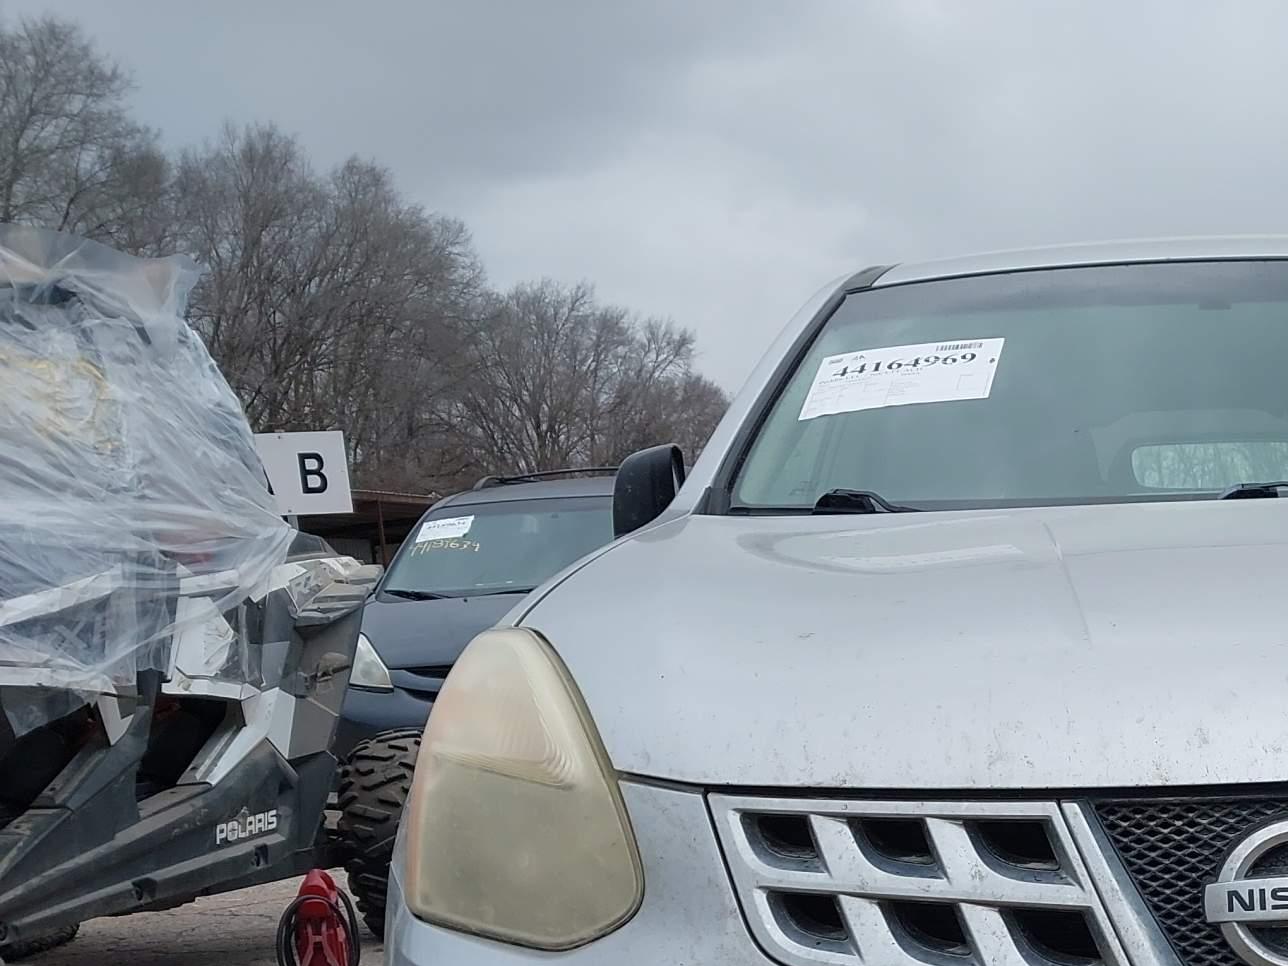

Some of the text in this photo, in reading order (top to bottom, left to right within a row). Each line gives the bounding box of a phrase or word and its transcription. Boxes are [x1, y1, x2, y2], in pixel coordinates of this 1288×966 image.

[832, 352, 977, 377] 44164969
[297, 452, 328, 494] B
[216, 809, 277, 844] POLARIS
